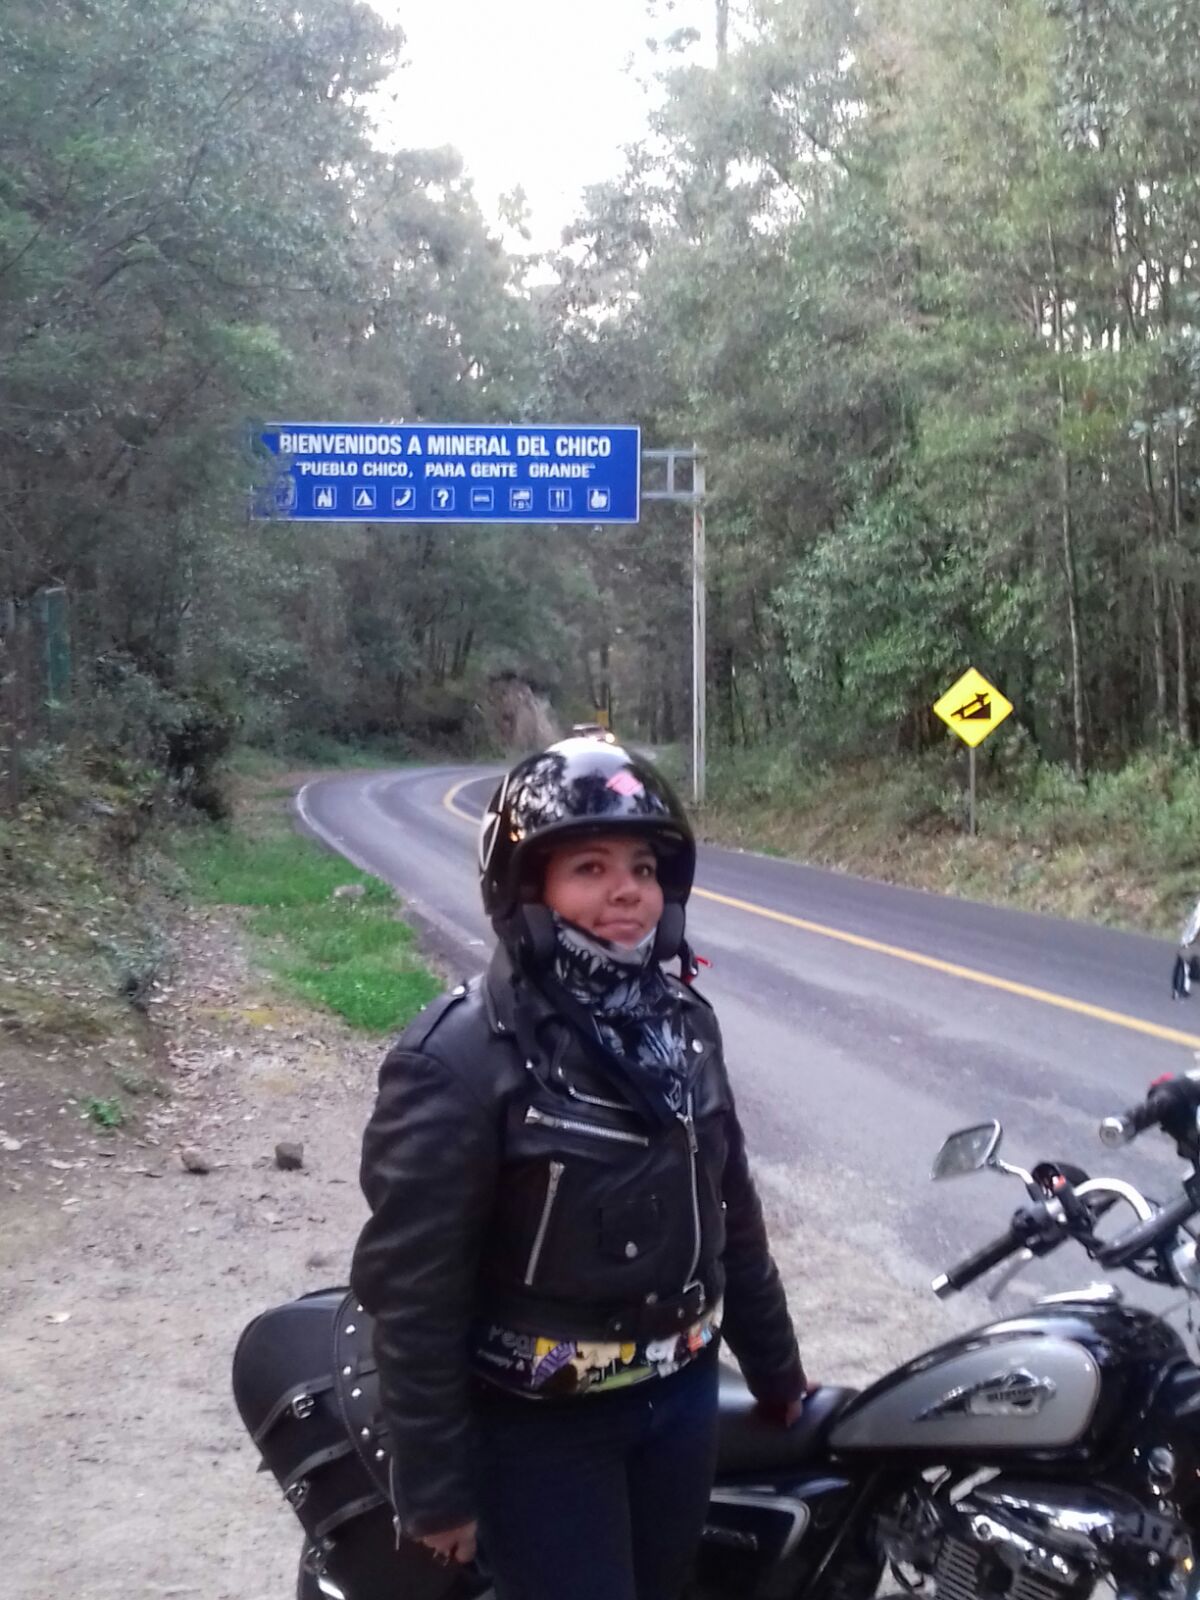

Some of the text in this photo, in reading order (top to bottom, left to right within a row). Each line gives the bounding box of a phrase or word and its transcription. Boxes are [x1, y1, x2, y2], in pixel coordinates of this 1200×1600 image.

[279, 433, 611, 457] BIENVENIDOS A MINERAL DEL CHICO
[362, 462, 413, 478] CHICO,
[424, 462, 466, 478] PARA
[470, 462, 518, 478] GENTE
